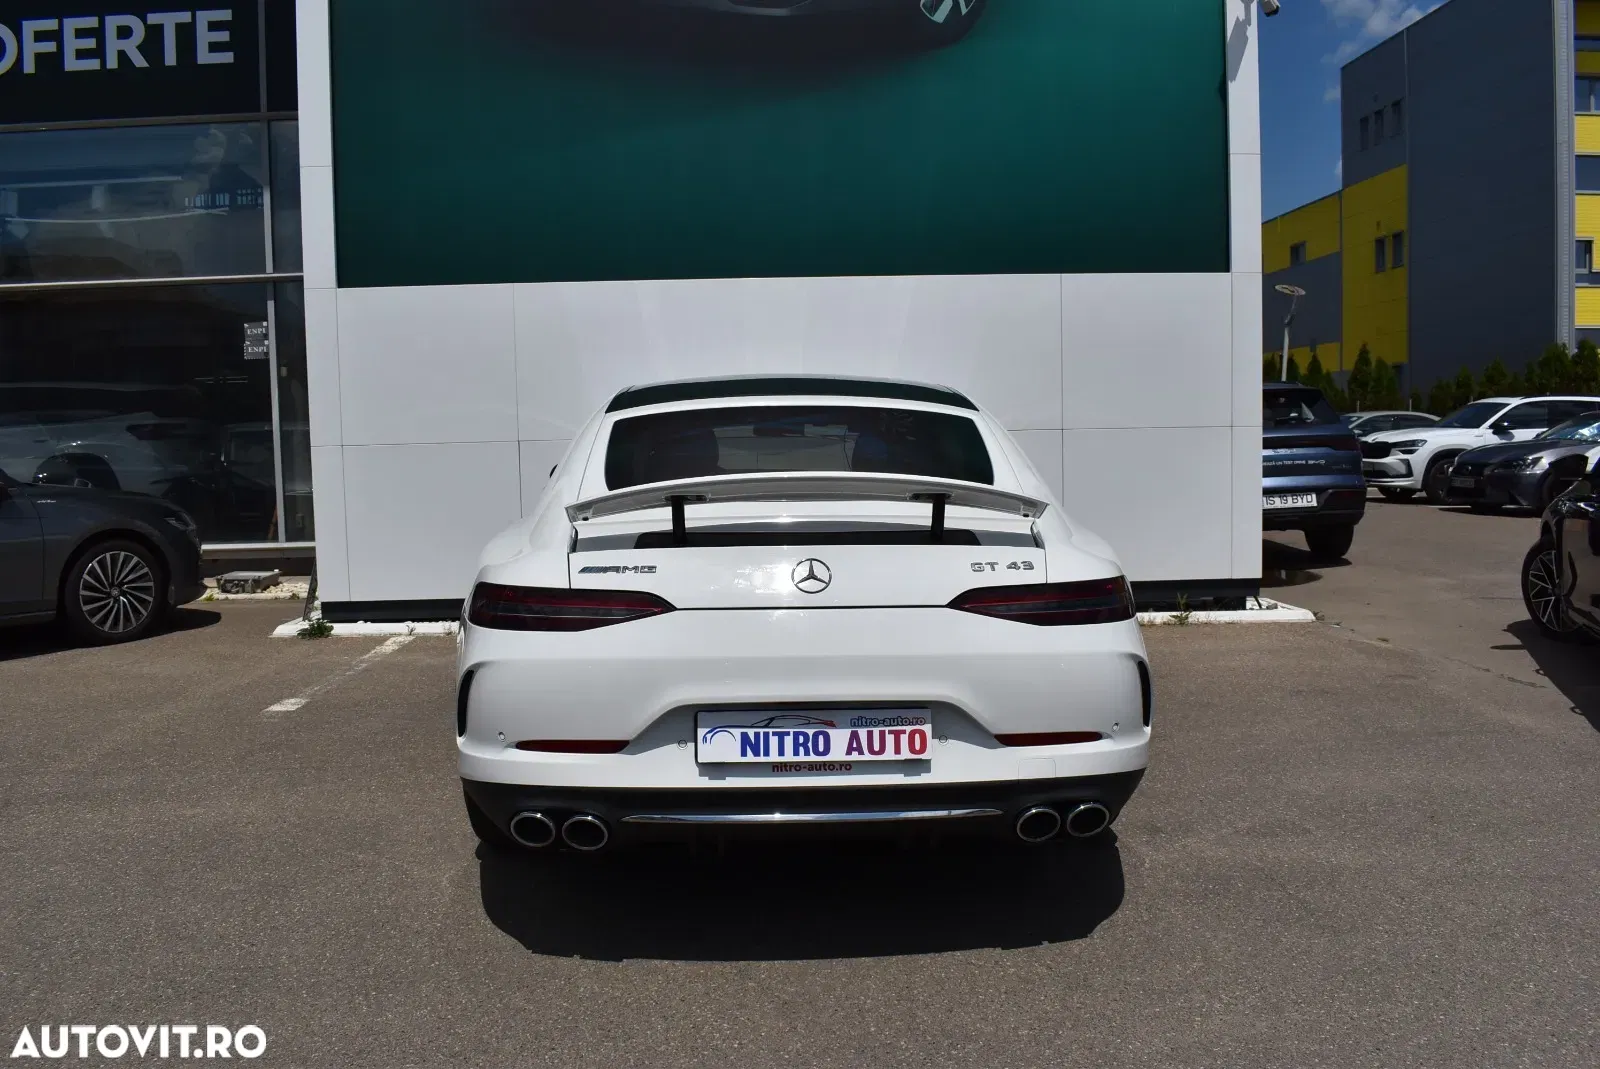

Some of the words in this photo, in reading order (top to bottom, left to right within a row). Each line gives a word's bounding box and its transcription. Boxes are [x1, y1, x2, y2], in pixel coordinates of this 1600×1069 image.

[1280, 494, 1288, 505] 19
[1292, 493, 1313, 504] BYD
[601, 565, 658, 574] AMG
[970, 561, 999, 572] GT
[1006, 560, 1035, 571] 43
[850, 715, 926, 727] nitro-auto.ro
[740, 730, 831, 758] NITRO
[845, 728, 928, 756] AUTO
[772, 763, 853, 773] nitro-auto.ro
